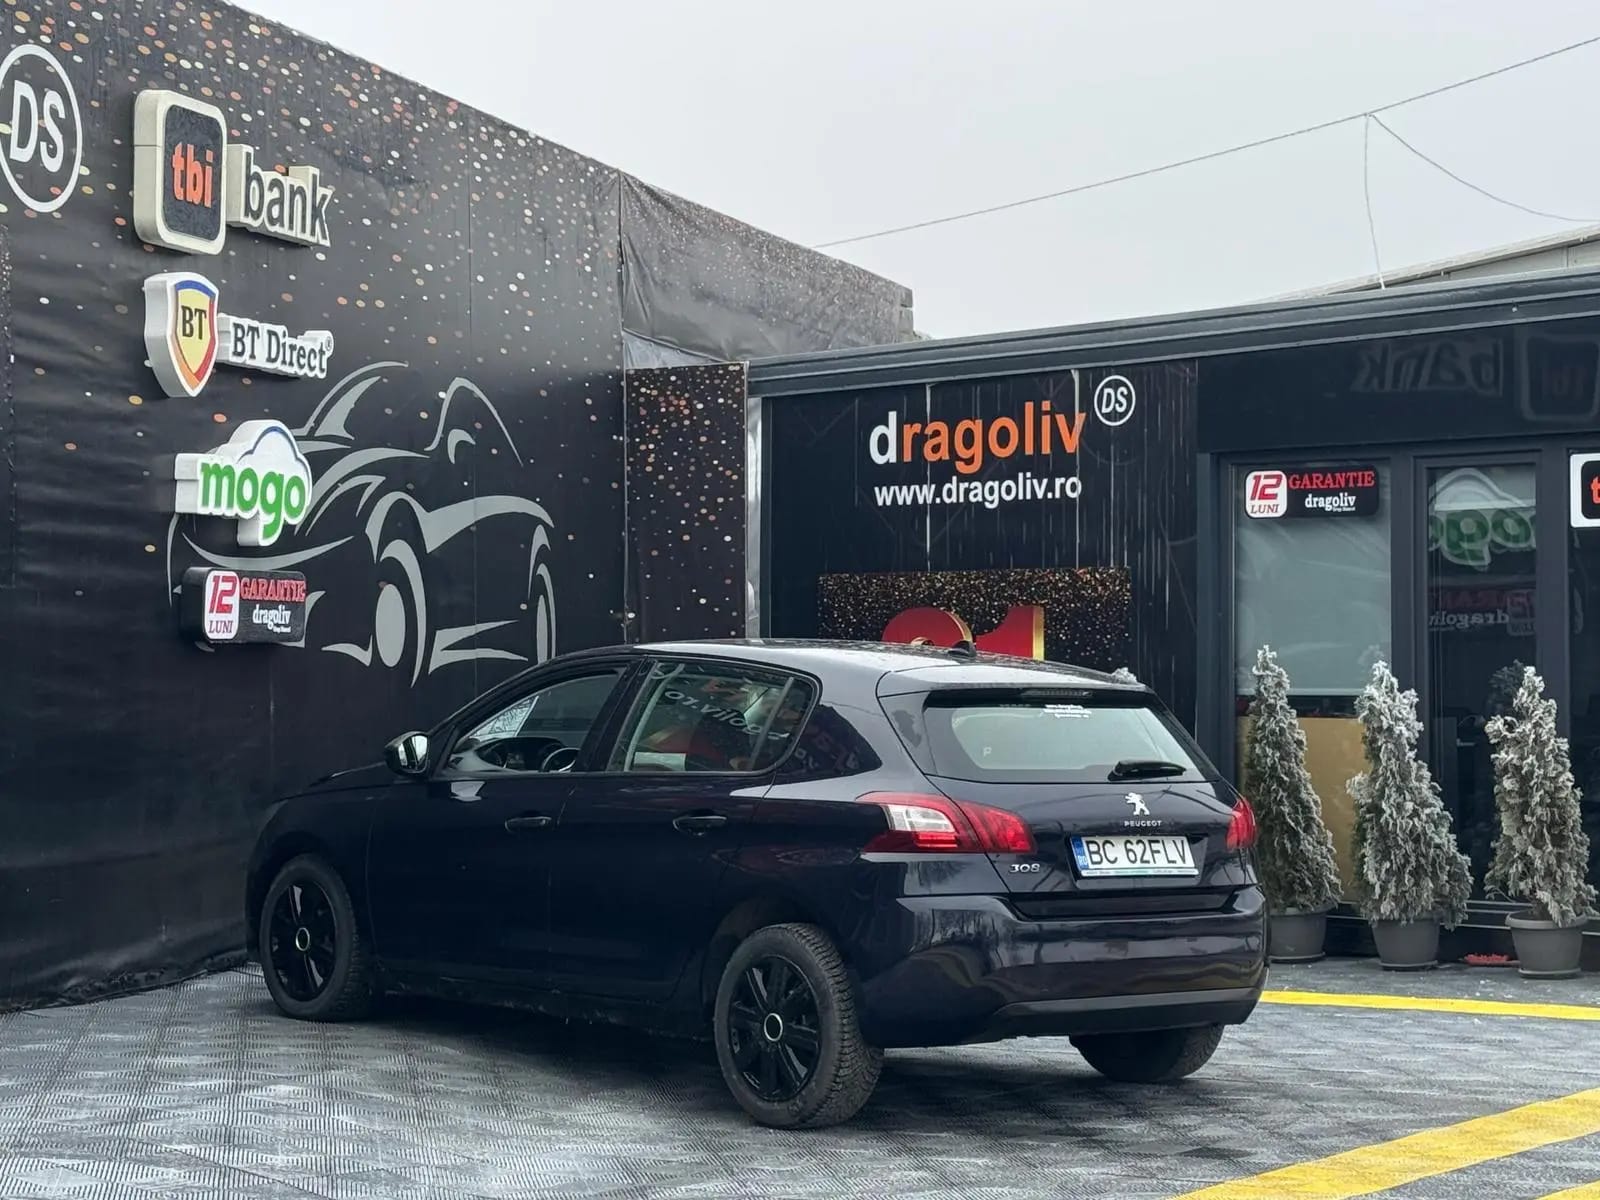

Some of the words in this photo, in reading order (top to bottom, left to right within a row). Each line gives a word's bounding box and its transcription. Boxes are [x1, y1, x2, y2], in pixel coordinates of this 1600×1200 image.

[10, 79, 66, 173] DS
[172, 142, 214, 208] tbi
[245, 150, 331, 246] bank
[181, 305, 207, 341] BT
[232, 322, 260, 360] BT
[1101, 386, 1128, 414] DS
[869, 400, 1087, 474] dragoliv
[201, 462, 307, 540] mogo
[874, 472, 1082, 509] www.dragoliv.ro
[1250, 474, 1283, 501] 12
[1289, 471, 1375, 489] GARANTIE
[1305, 492, 1356, 511] dragoliv
[1250, 504, 1280, 514] LUNI
[209, 575, 237, 614] 12
[240, 577, 306, 603] GARANTIE
[208, 620, 233, 634] LUNI
[253, 604, 291, 630] dragoliv
[1010, 863, 1041, 873] 308
[1086, 840, 1118, 865] BC
